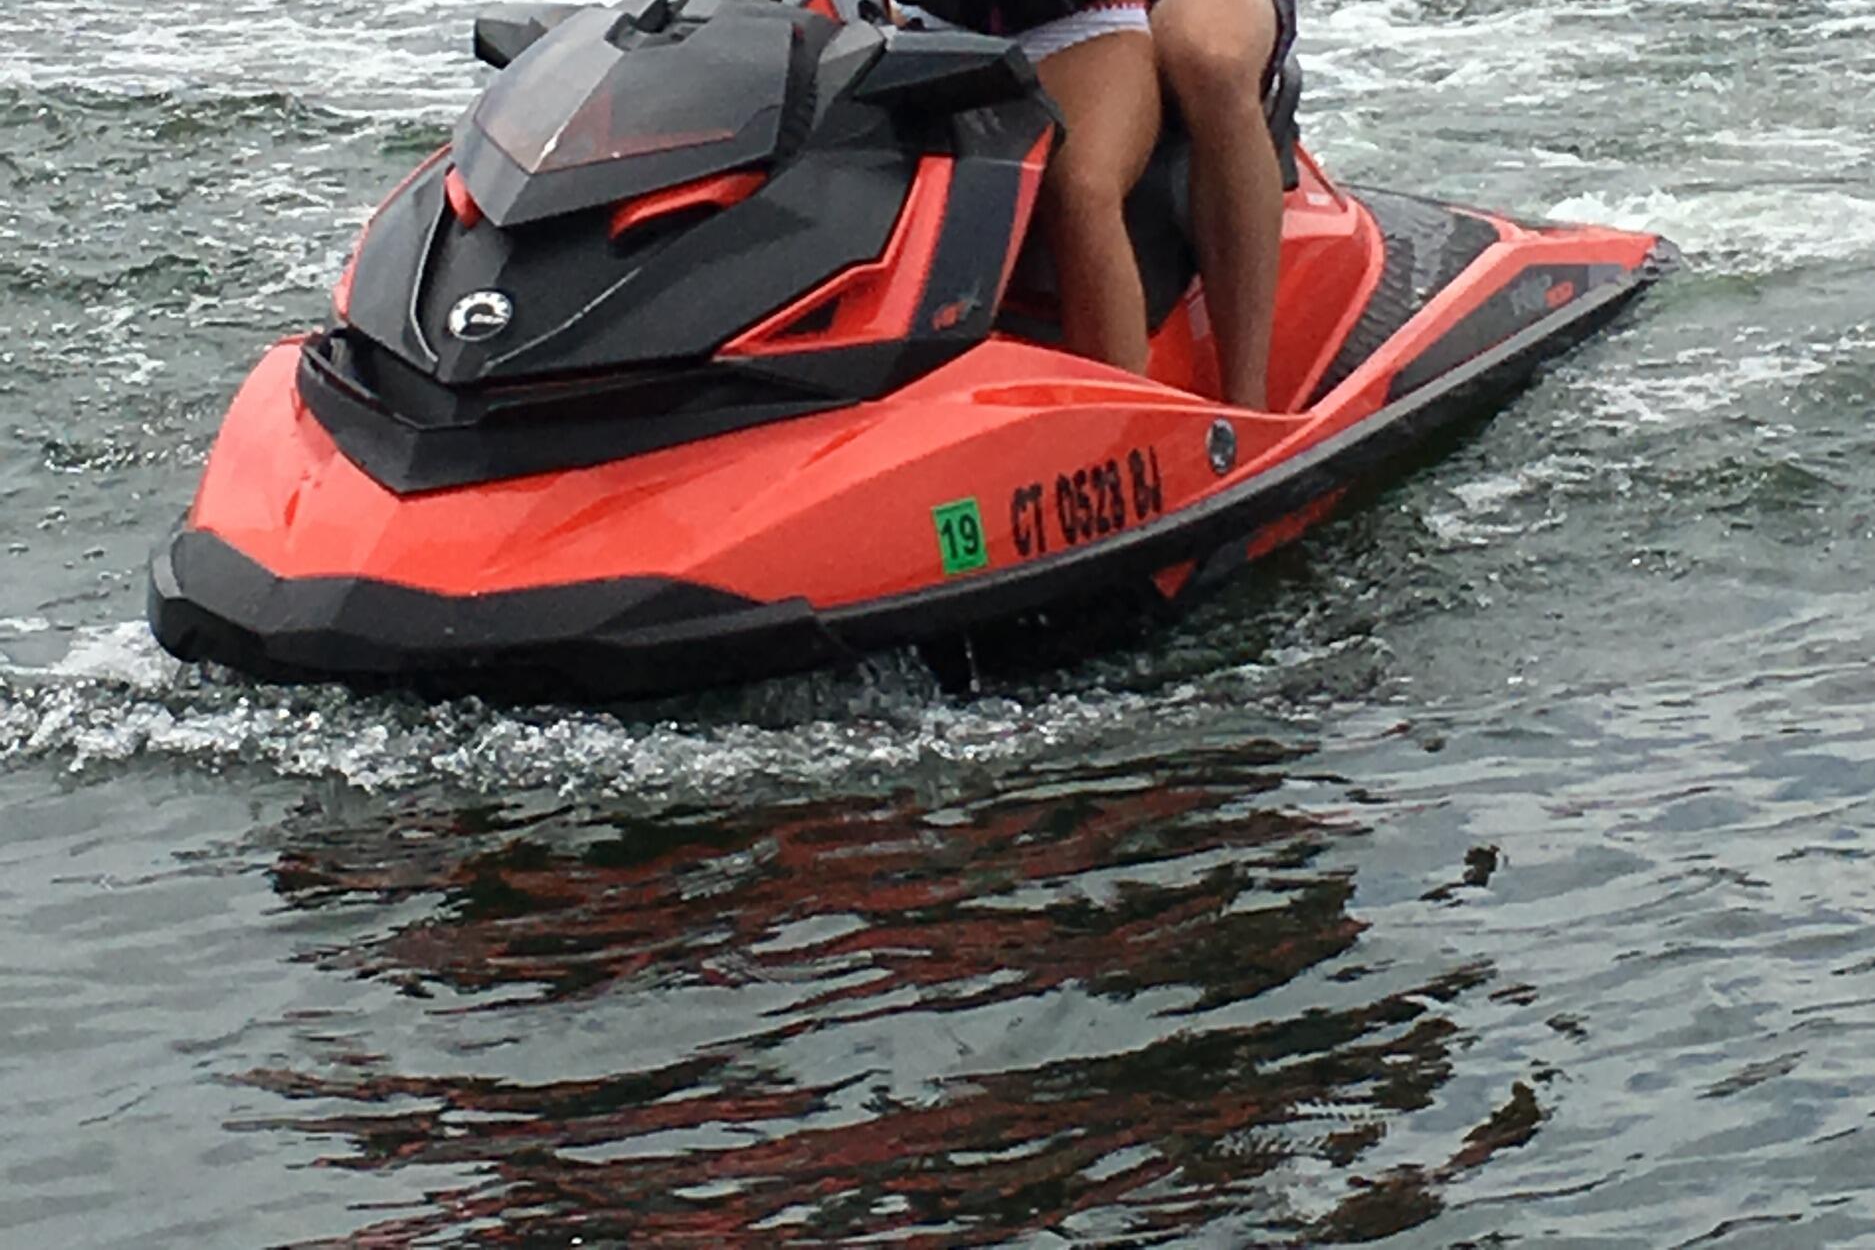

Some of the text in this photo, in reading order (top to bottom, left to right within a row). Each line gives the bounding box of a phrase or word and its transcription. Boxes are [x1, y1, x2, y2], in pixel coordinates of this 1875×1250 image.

[940, 512, 979, 560] 19
[1010, 481, 1047, 557] CT
[1055, 457, 1126, 545] 0523
